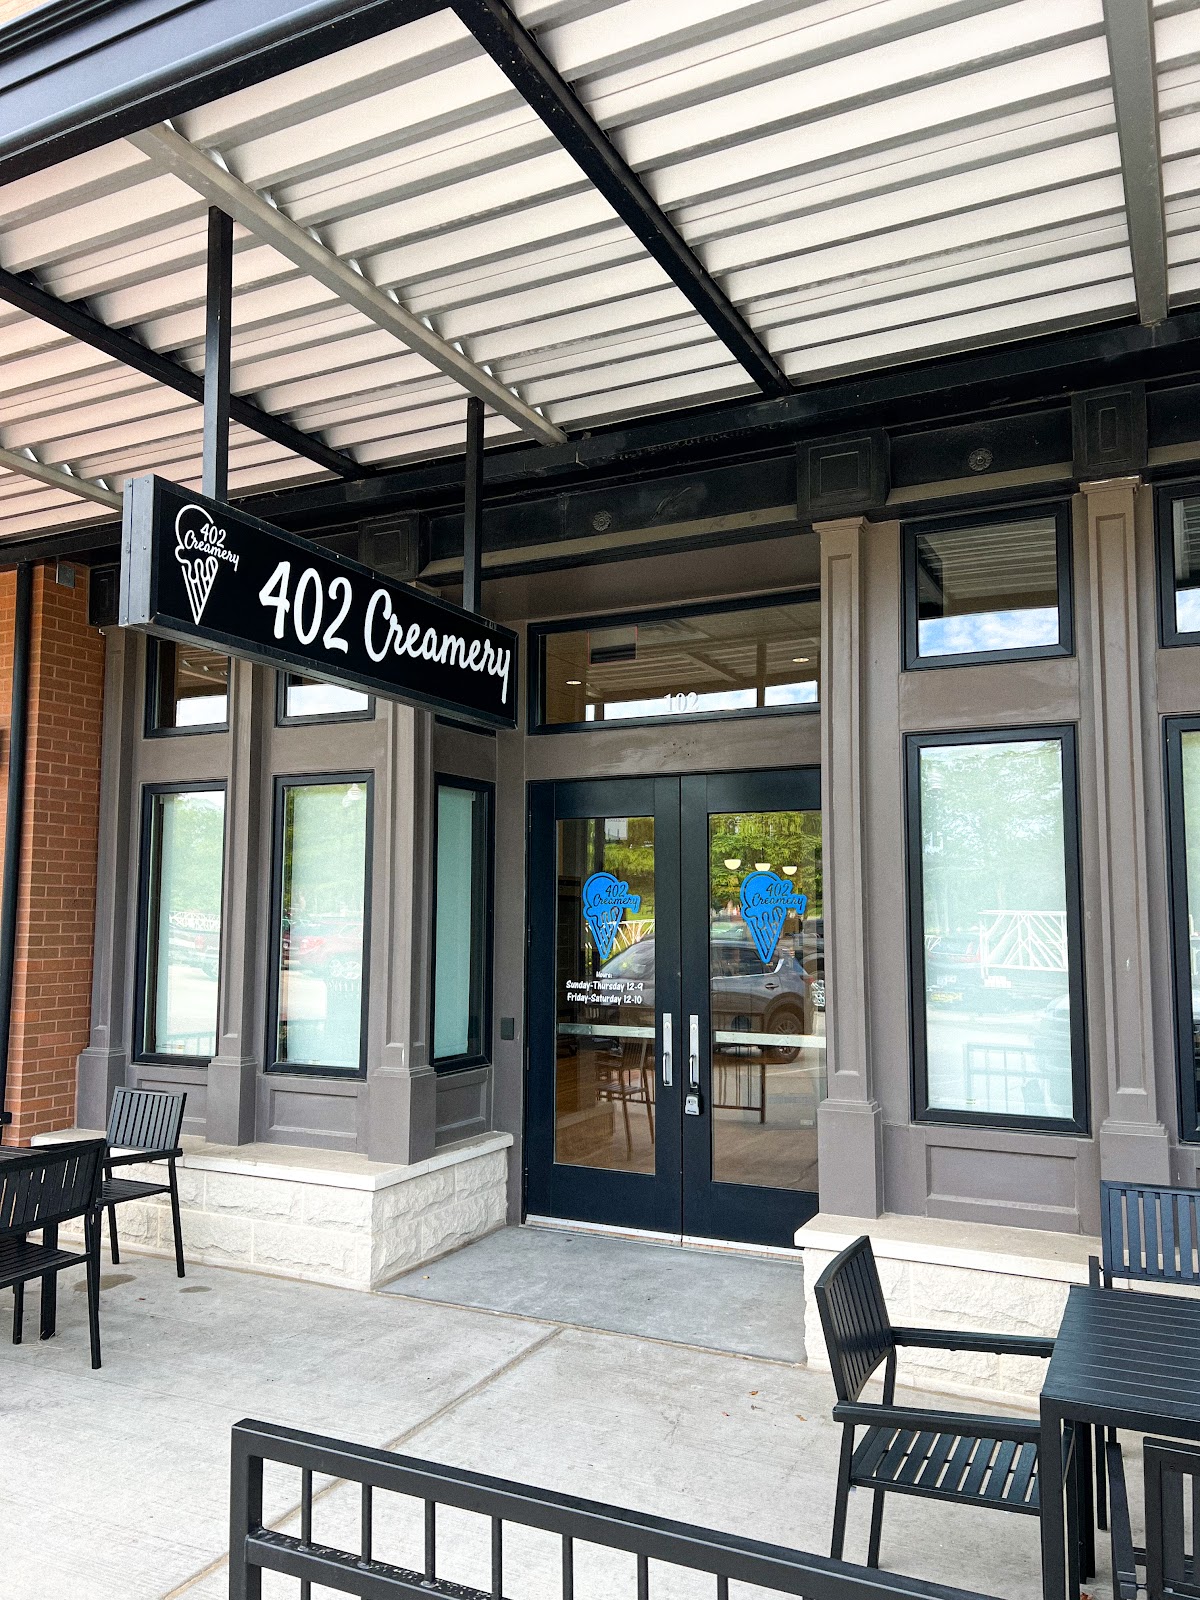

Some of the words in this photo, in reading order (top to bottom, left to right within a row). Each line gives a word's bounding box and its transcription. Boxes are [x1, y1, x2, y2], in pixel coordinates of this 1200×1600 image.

[200, 522, 226, 548] 402
[184, 529, 240, 572] Creamery
[258, 561, 353, 654] 402
[364, 588, 511, 705] Creamery
[664, 691, 699, 712] 102
[605, 884, 626, 898] 402
[766, 883, 790, 897] 402
[593, 894, 638, 910] Creamery
[752, 893, 804, 911] Creamery
[566, 980, 625, 992] Sunday-Thursday
[626, 982, 644, 991] 12-9
[567, 992, 621, 1005] Friday-Saturday
[623, 994, 642, 1004] 12-10
